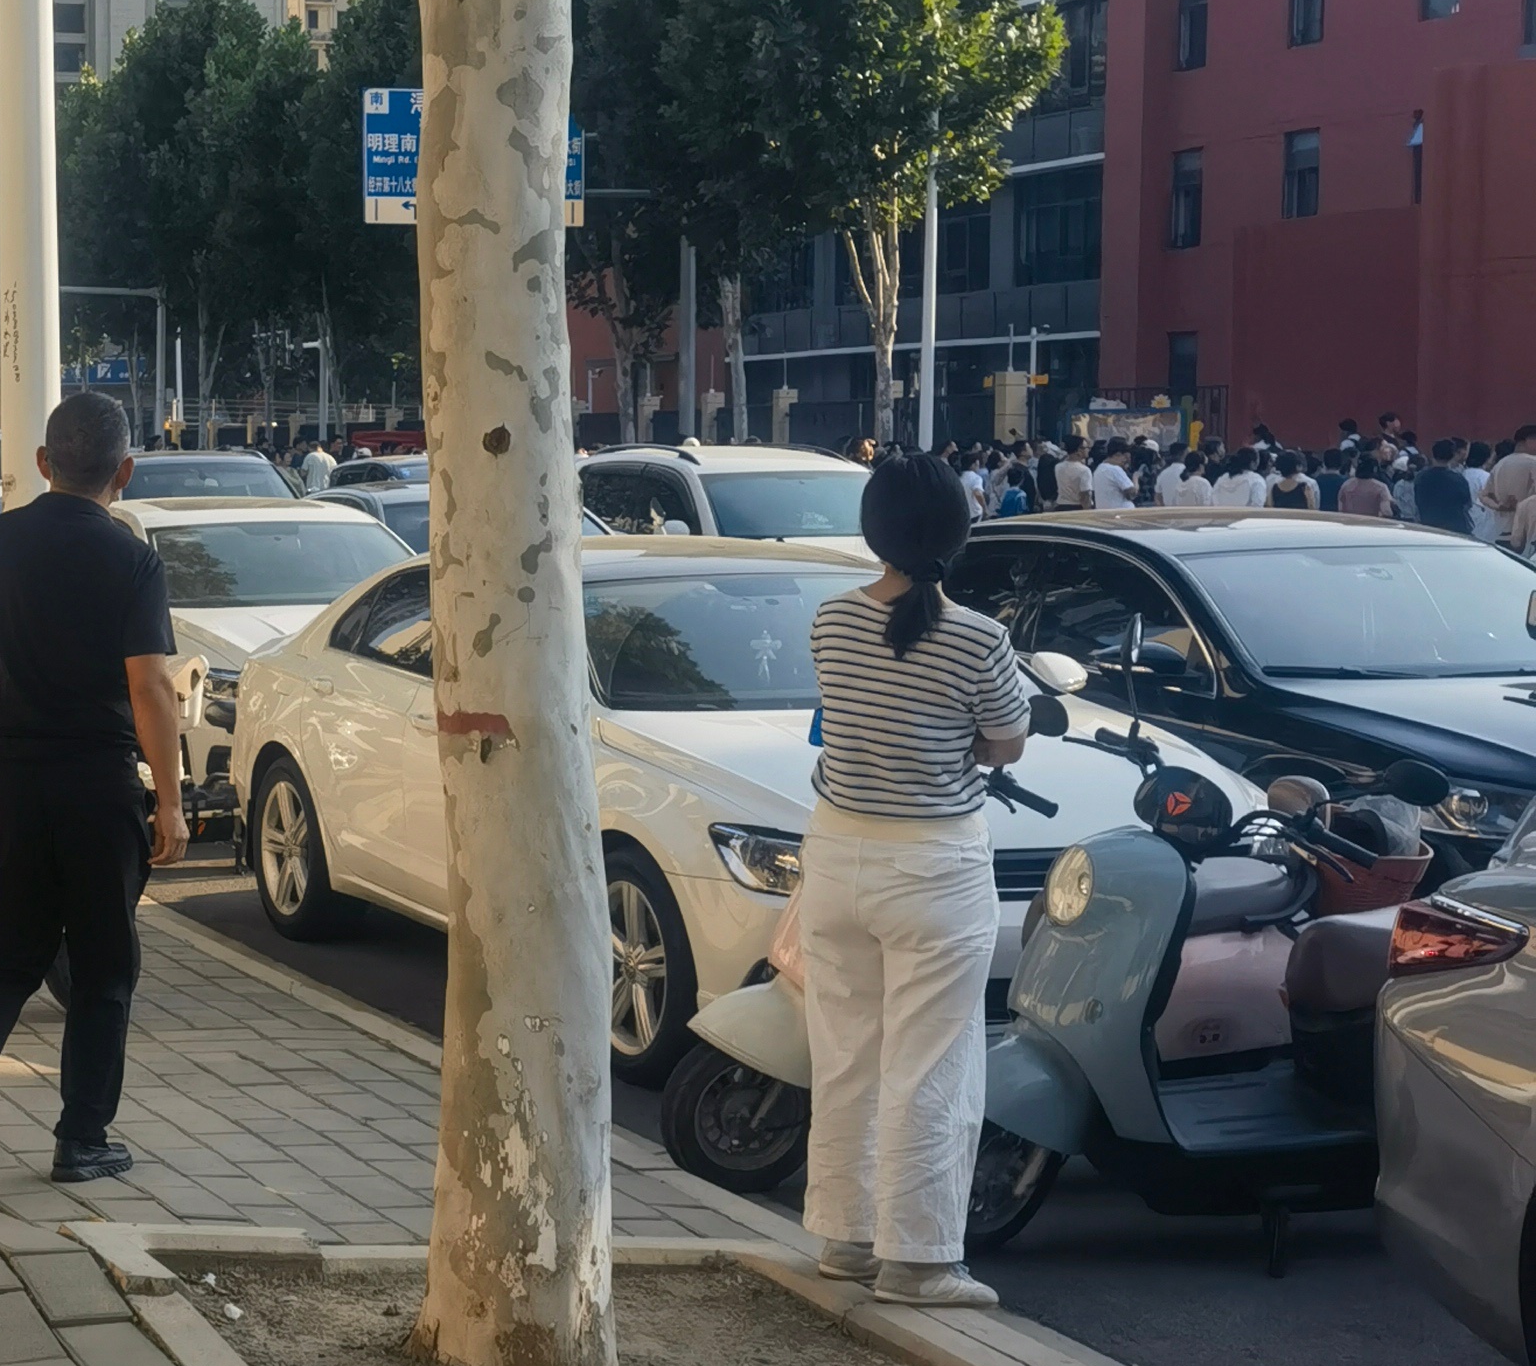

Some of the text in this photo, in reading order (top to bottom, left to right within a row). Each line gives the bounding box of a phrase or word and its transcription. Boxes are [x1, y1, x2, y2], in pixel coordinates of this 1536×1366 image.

[369, 91, 384, 106] 南
[367, 133, 417, 153] 明理南
[372, 155, 395, 165] Mingli
[397, 155, 412, 164] Rd.
